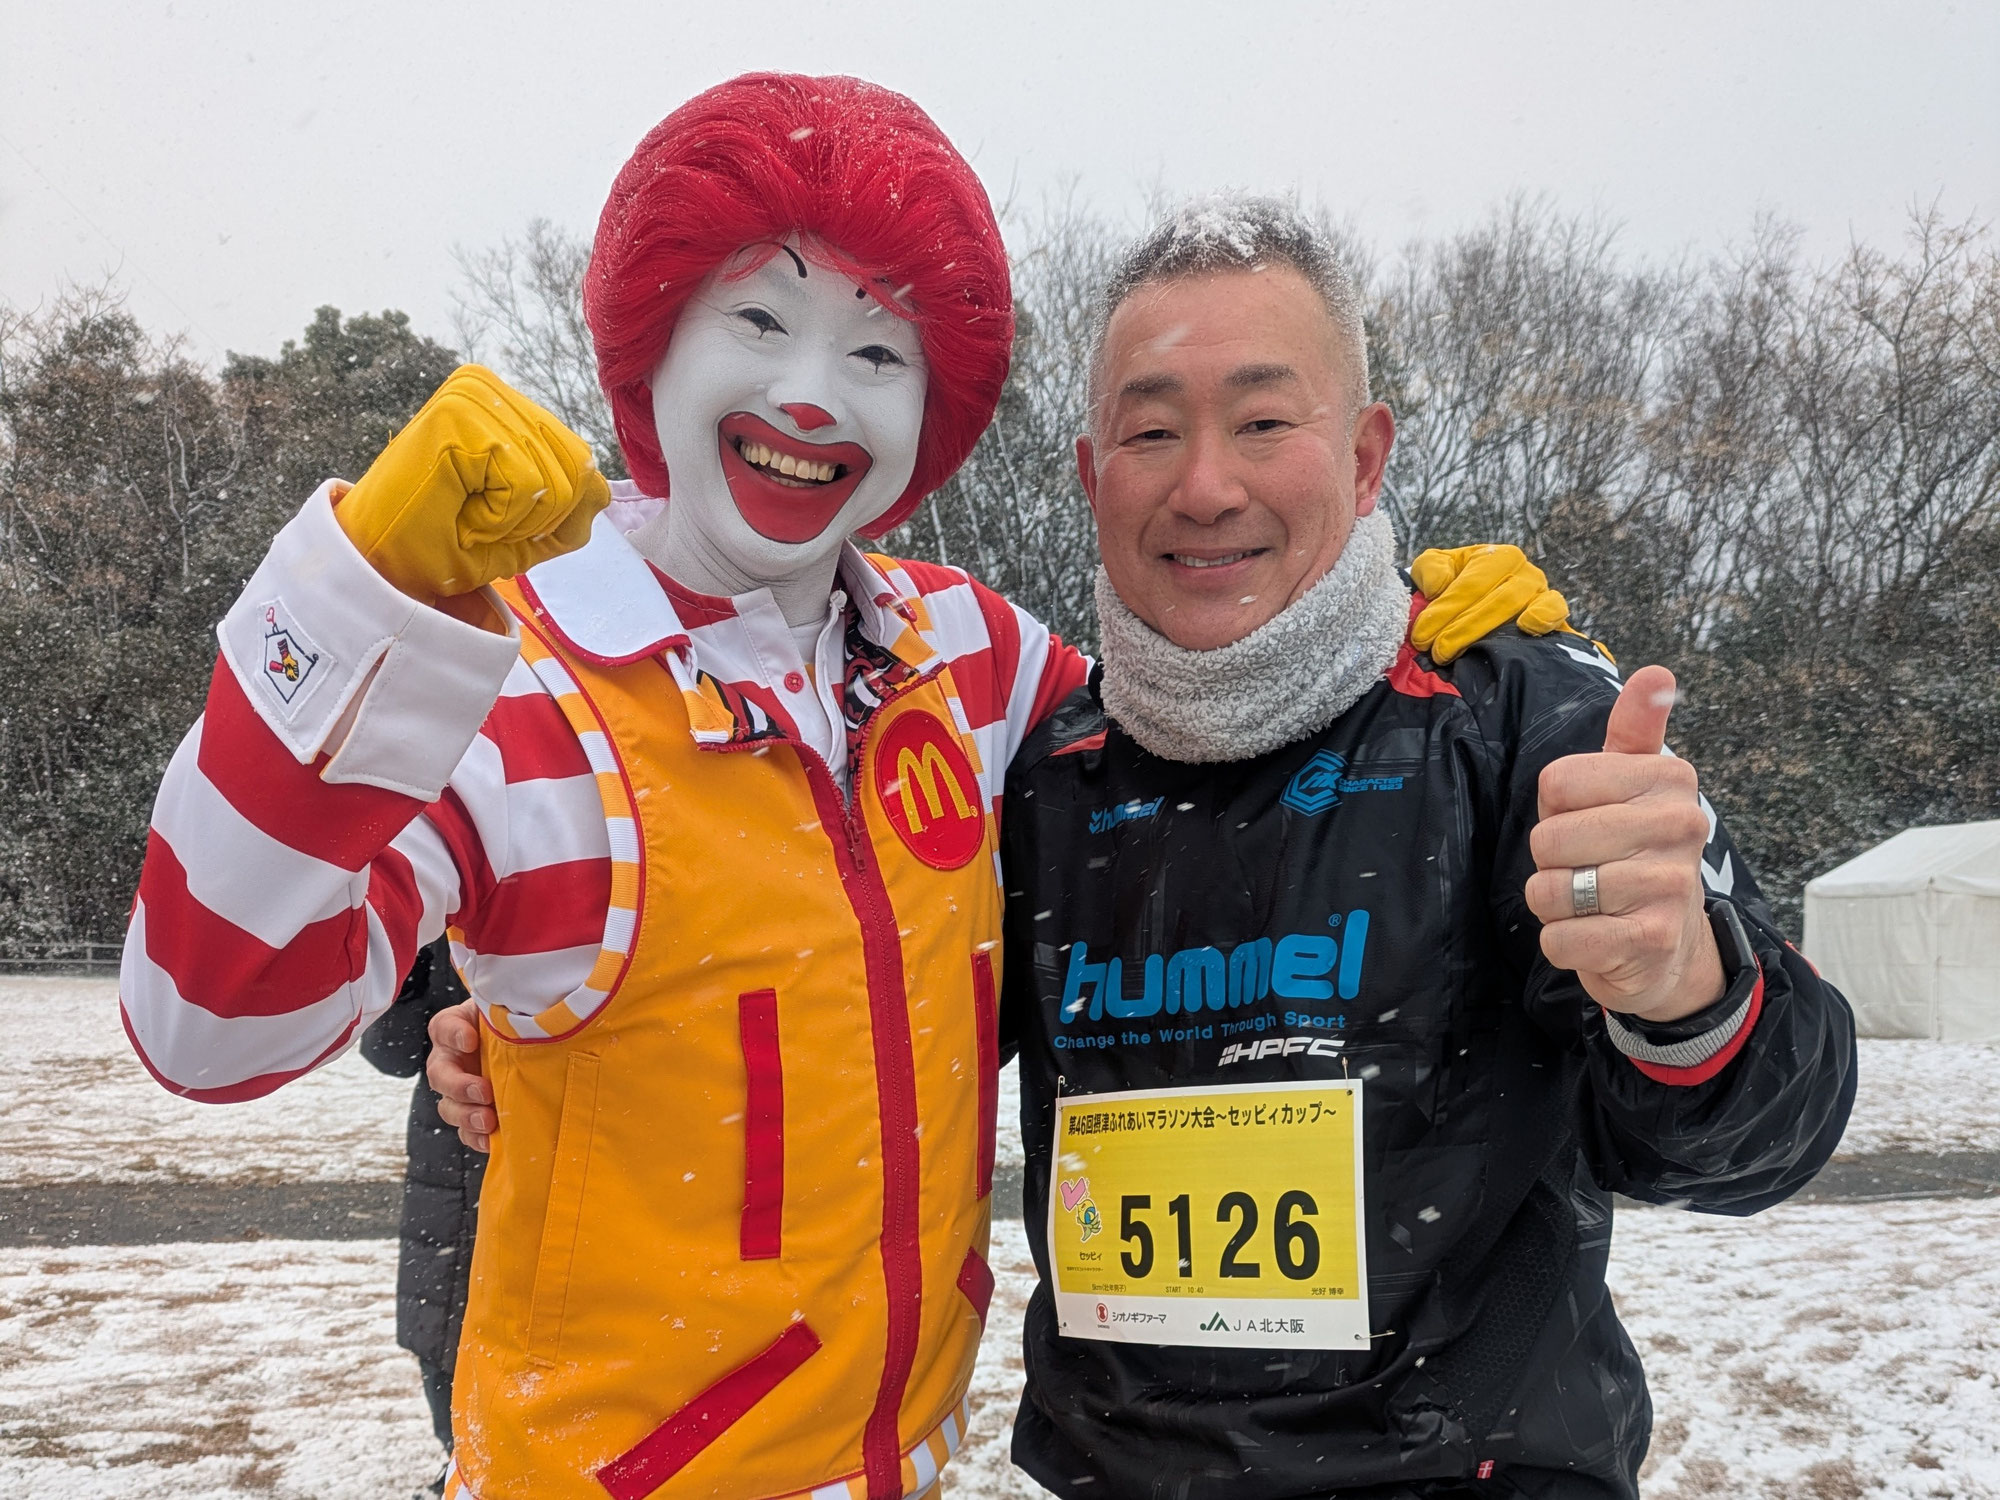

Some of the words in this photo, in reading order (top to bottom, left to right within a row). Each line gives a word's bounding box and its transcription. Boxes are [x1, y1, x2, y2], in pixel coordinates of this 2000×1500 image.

[1339, 777, 1404, 786] CHARACTER
[1338, 784, 1368, 793] SINCE
[1054, 1034, 1116, 1049] Change
[1122, 1030, 1151, 1045] the
[1159, 1025, 1213, 1044] World
[1221, 1013, 1277, 1038] Through
[1284, 1011, 1345, 1029] Sport
[1232, 1036, 1346, 1063] HPFC
[1120, 1190, 1320, 1280] 5126
[1079, 1251, 1102, 1261] セッピィ
[1187, 1286, 1204, 1294] 10:40
[1112, 1311, 1167, 1324] シオノギファーマ
